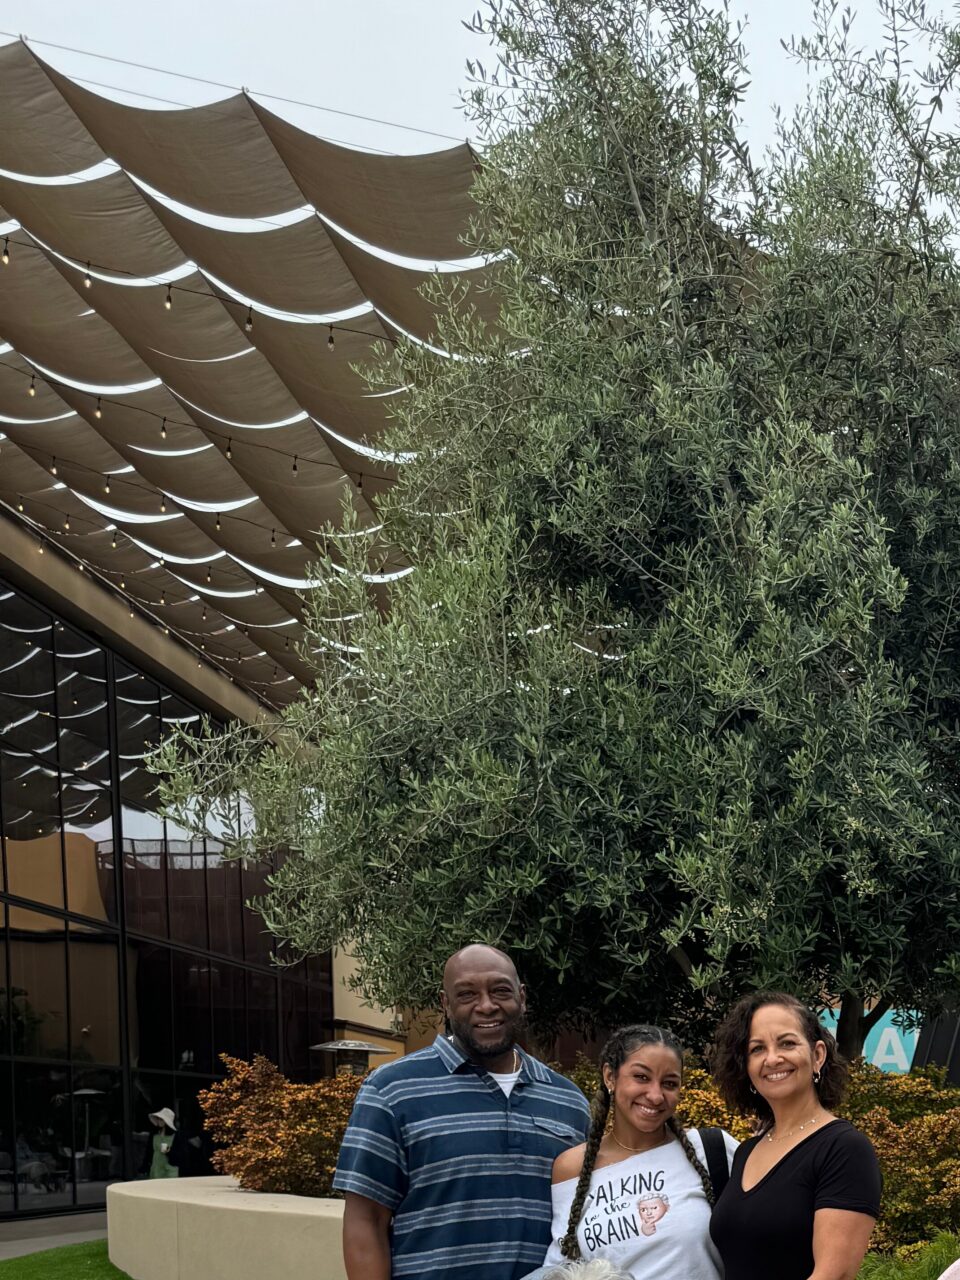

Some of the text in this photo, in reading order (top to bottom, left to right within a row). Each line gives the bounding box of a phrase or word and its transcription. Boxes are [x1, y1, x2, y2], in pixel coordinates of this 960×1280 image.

[588, 1170, 665, 1206] ALKING
[603, 1199, 631, 1216] the
[583, 1214, 640, 1252] BRAIN
